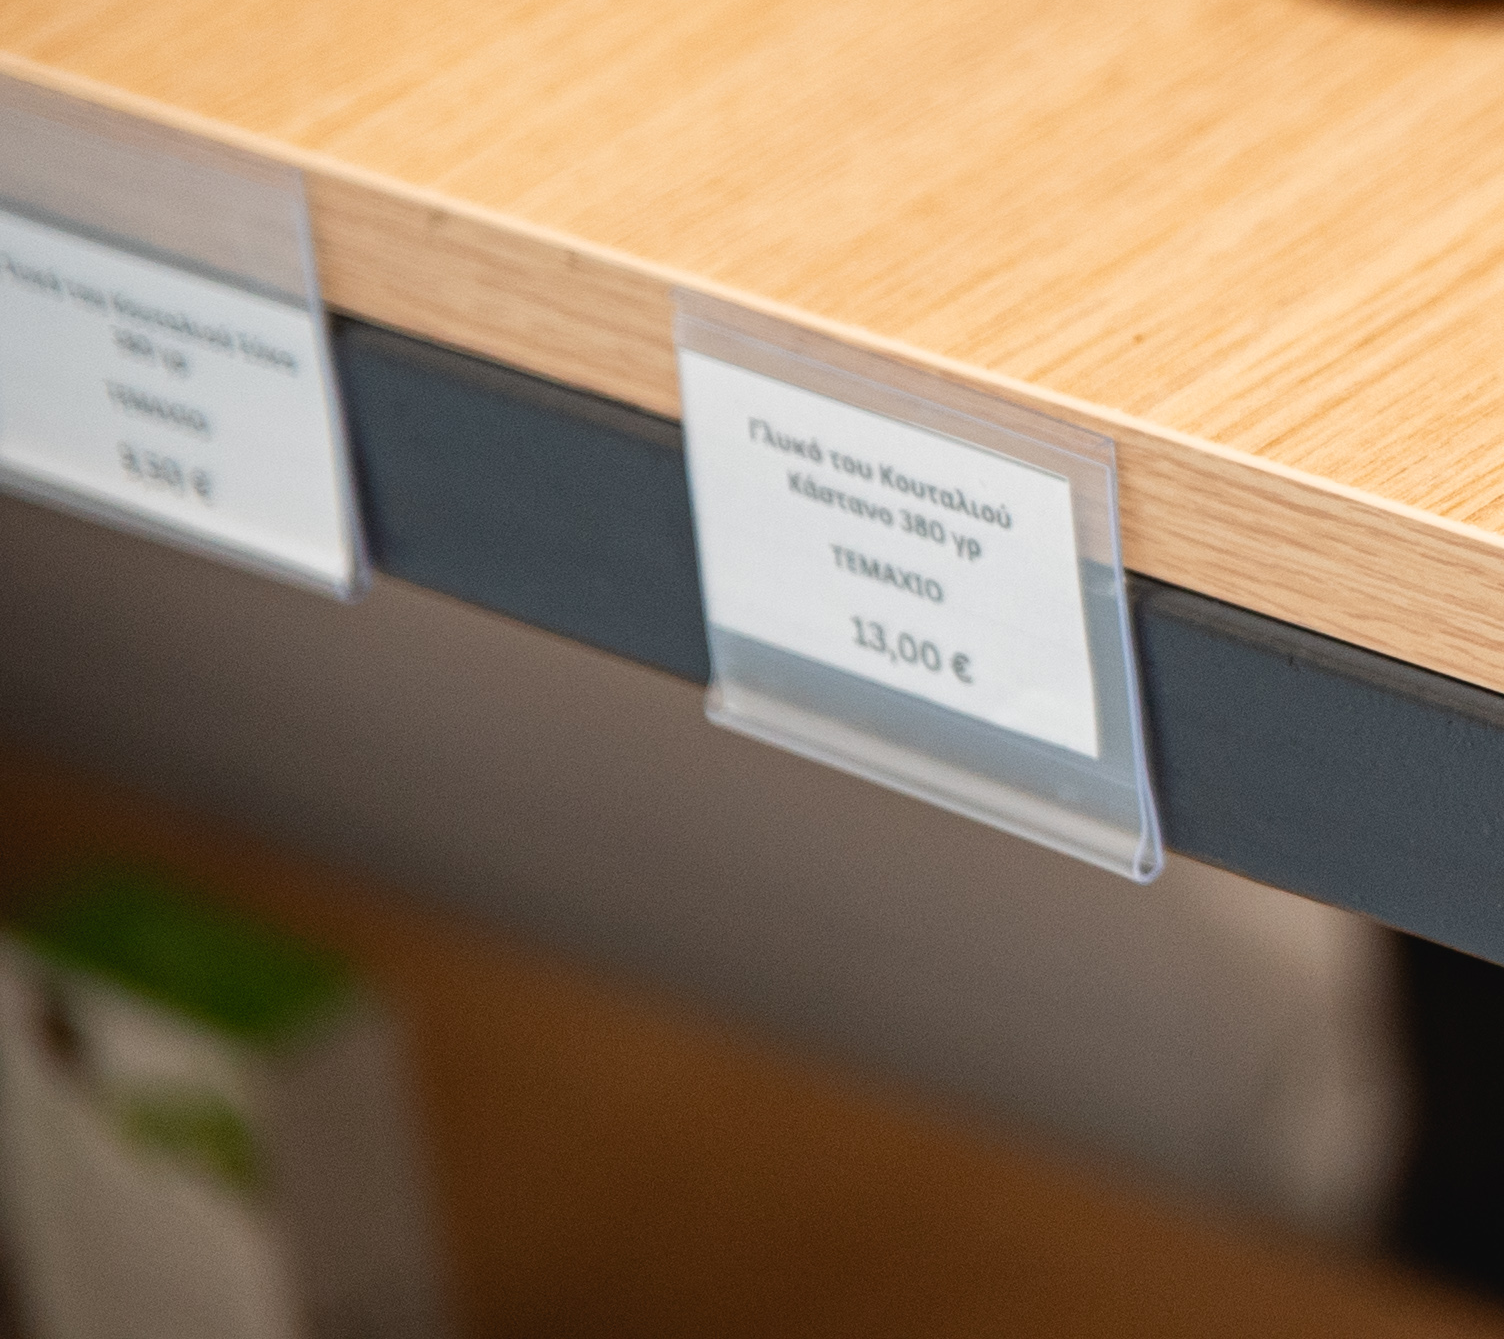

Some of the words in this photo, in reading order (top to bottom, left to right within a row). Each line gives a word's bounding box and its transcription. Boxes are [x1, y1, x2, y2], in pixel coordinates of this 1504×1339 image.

[787, 470, 895, 529] Κάστανο
[898, 510, 947, 545] 380
[952, 532, 983, 562] γρ
[829, 447, 875, 481] του
[878, 461, 1014, 531] Κουταλιού
[830, 543, 945, 605] ΤΕΜΑΧΙΟ
[850, 613, 943, 675] 13,00
[949, 649, 975, 685] €
